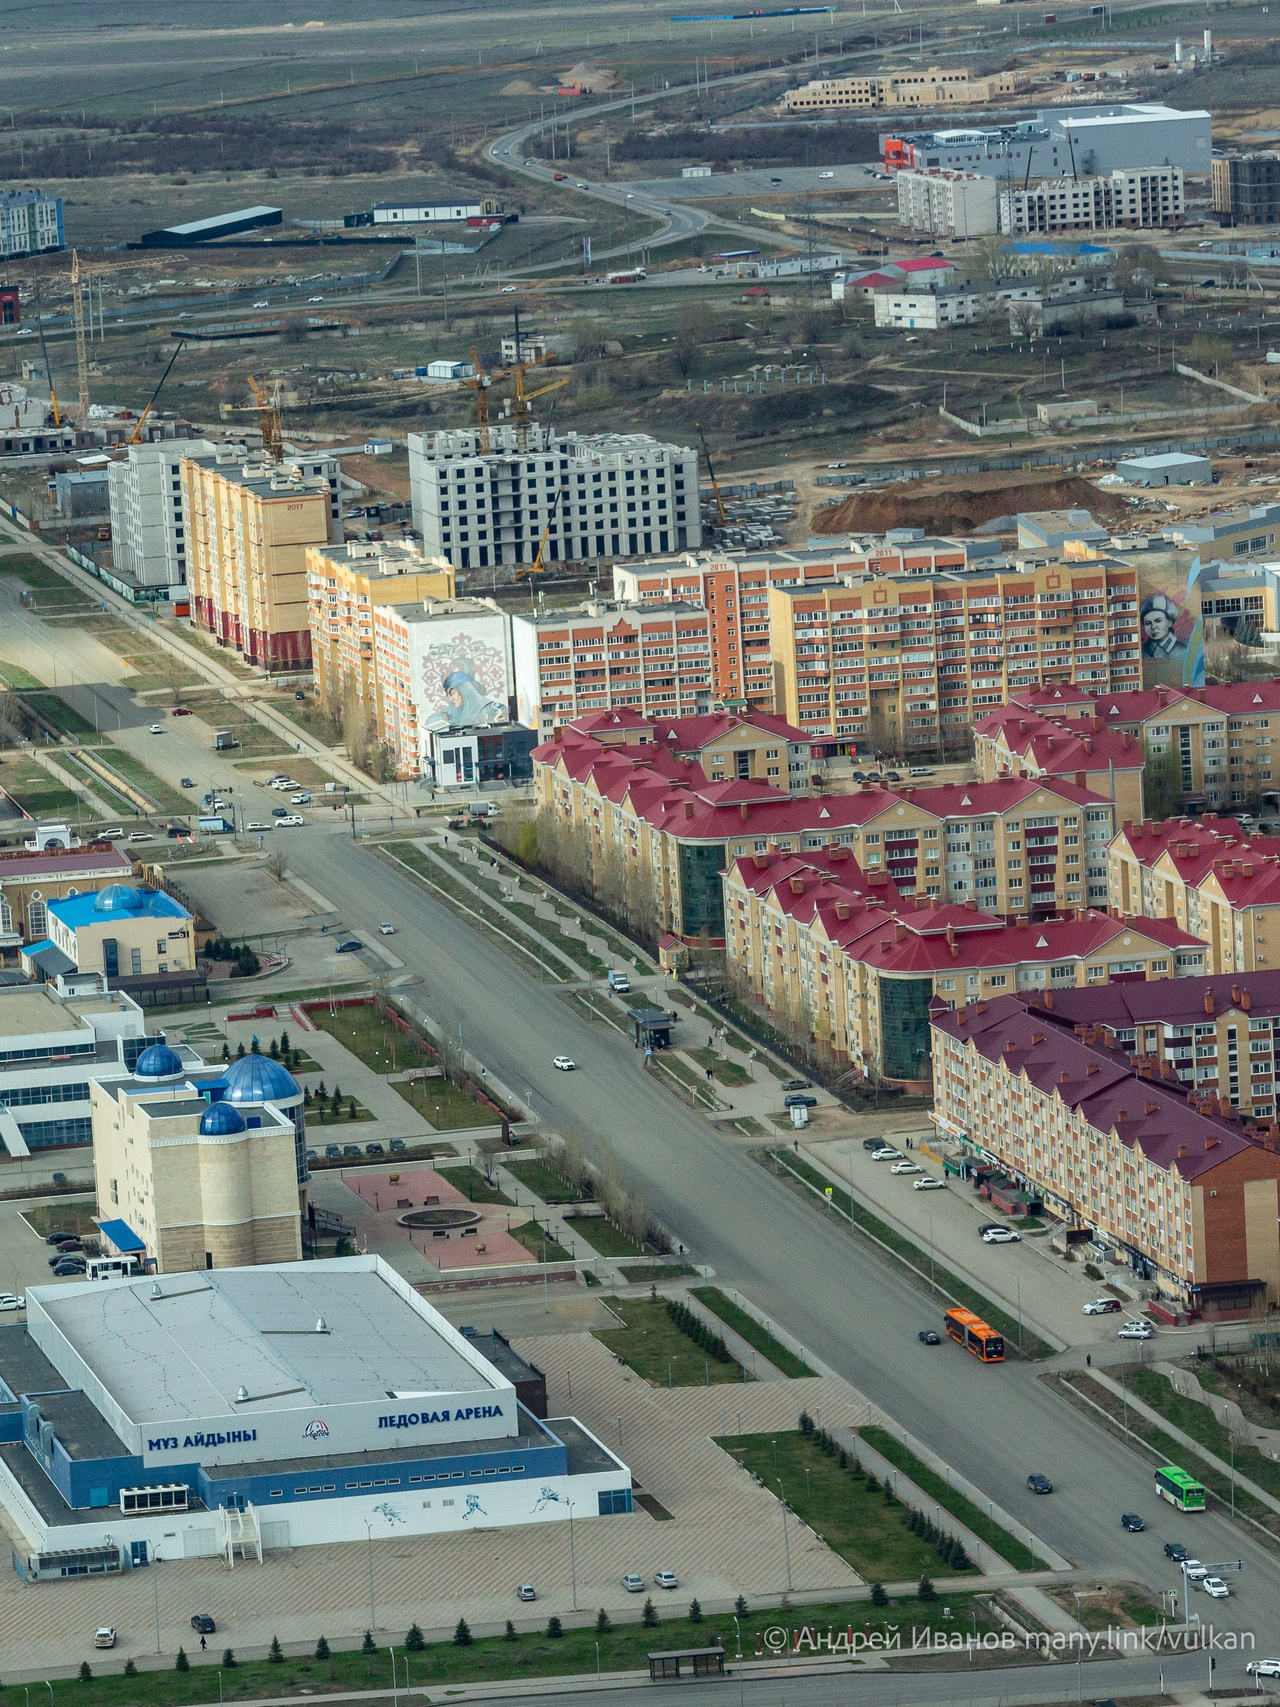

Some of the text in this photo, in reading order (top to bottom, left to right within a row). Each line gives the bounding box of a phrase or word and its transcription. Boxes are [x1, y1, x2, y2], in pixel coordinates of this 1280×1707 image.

[287, 503, 303, 511] 2017
[876, 549, 892, 557] 2011
[710, 563, 727, 571] 2011
[378, 1405, 504, 1429] ЛЕДОВАЯ АРЕНА
[148, 1429, 257, 1451] МҰЗ АЙДЫНЫ
